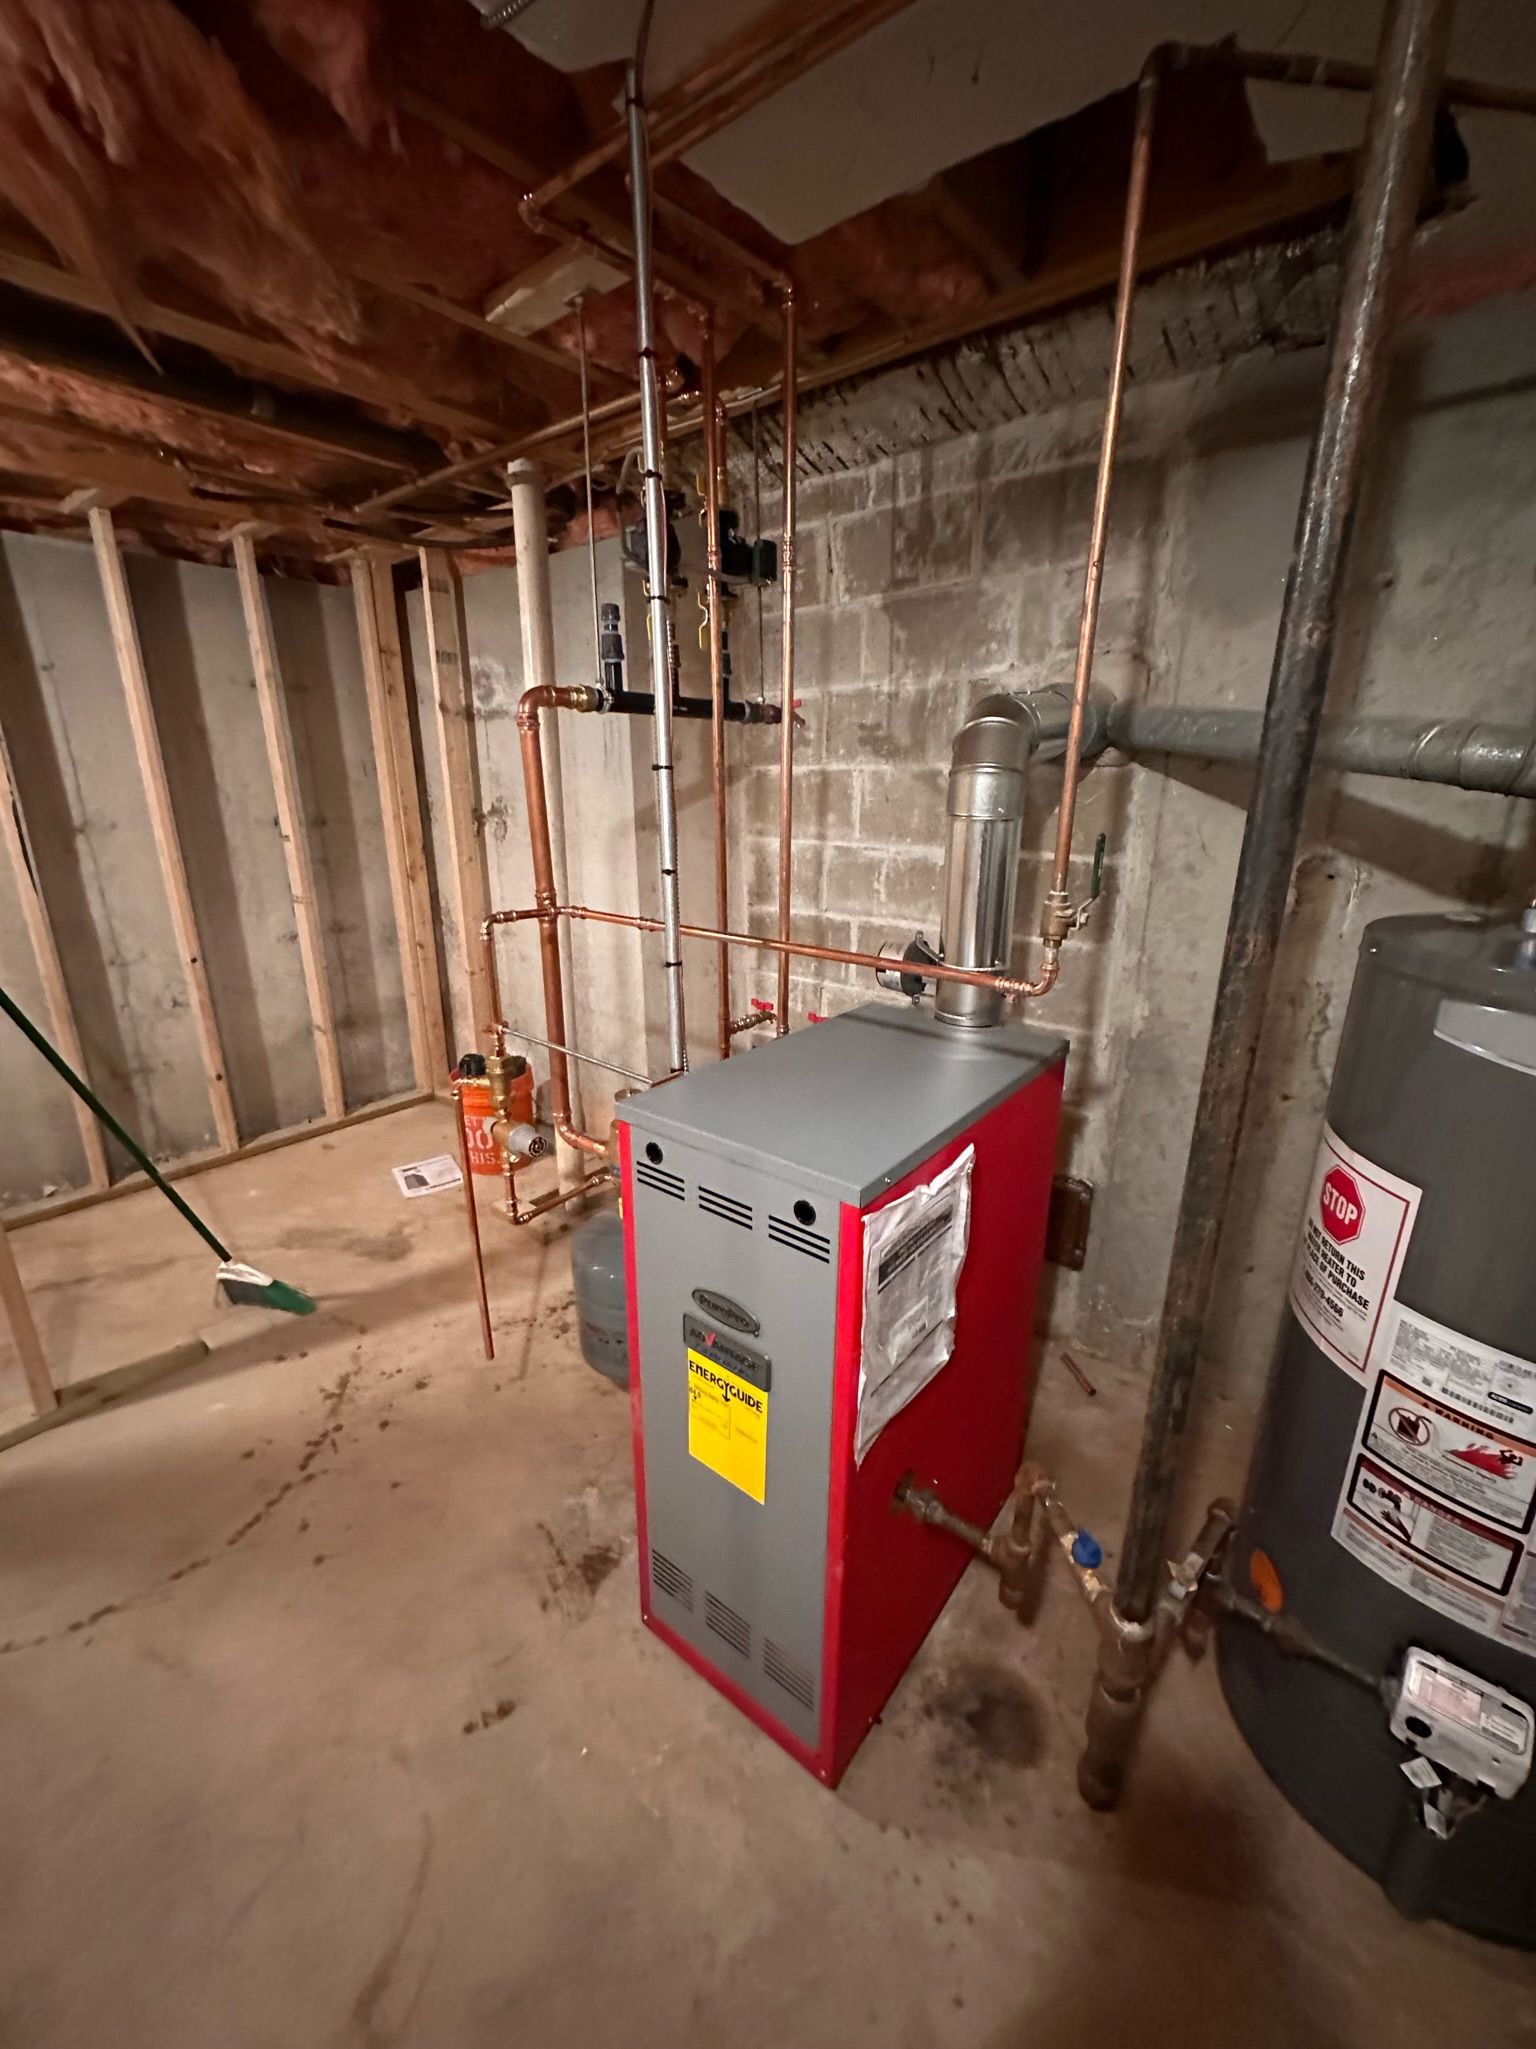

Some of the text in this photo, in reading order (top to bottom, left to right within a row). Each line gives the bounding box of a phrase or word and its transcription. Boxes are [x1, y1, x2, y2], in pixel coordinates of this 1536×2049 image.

[470, 1151, 500, 1164] HIS.
[1323, 1182, 1358, 1225] STOP
[1320, 1243, 1345, 1279] HEATER
[1346, 1270, 1357, 1288] TO
[1322, 1236, 1346, 1266] RETURN
[1347, 1256, 1366, 1281] THIS
[1319, 1261, 1328, 1273] OF
[1327, 1269, 1371, 1311] PURCHASE
[1433, 1405, 1495, 1440] WARNING
